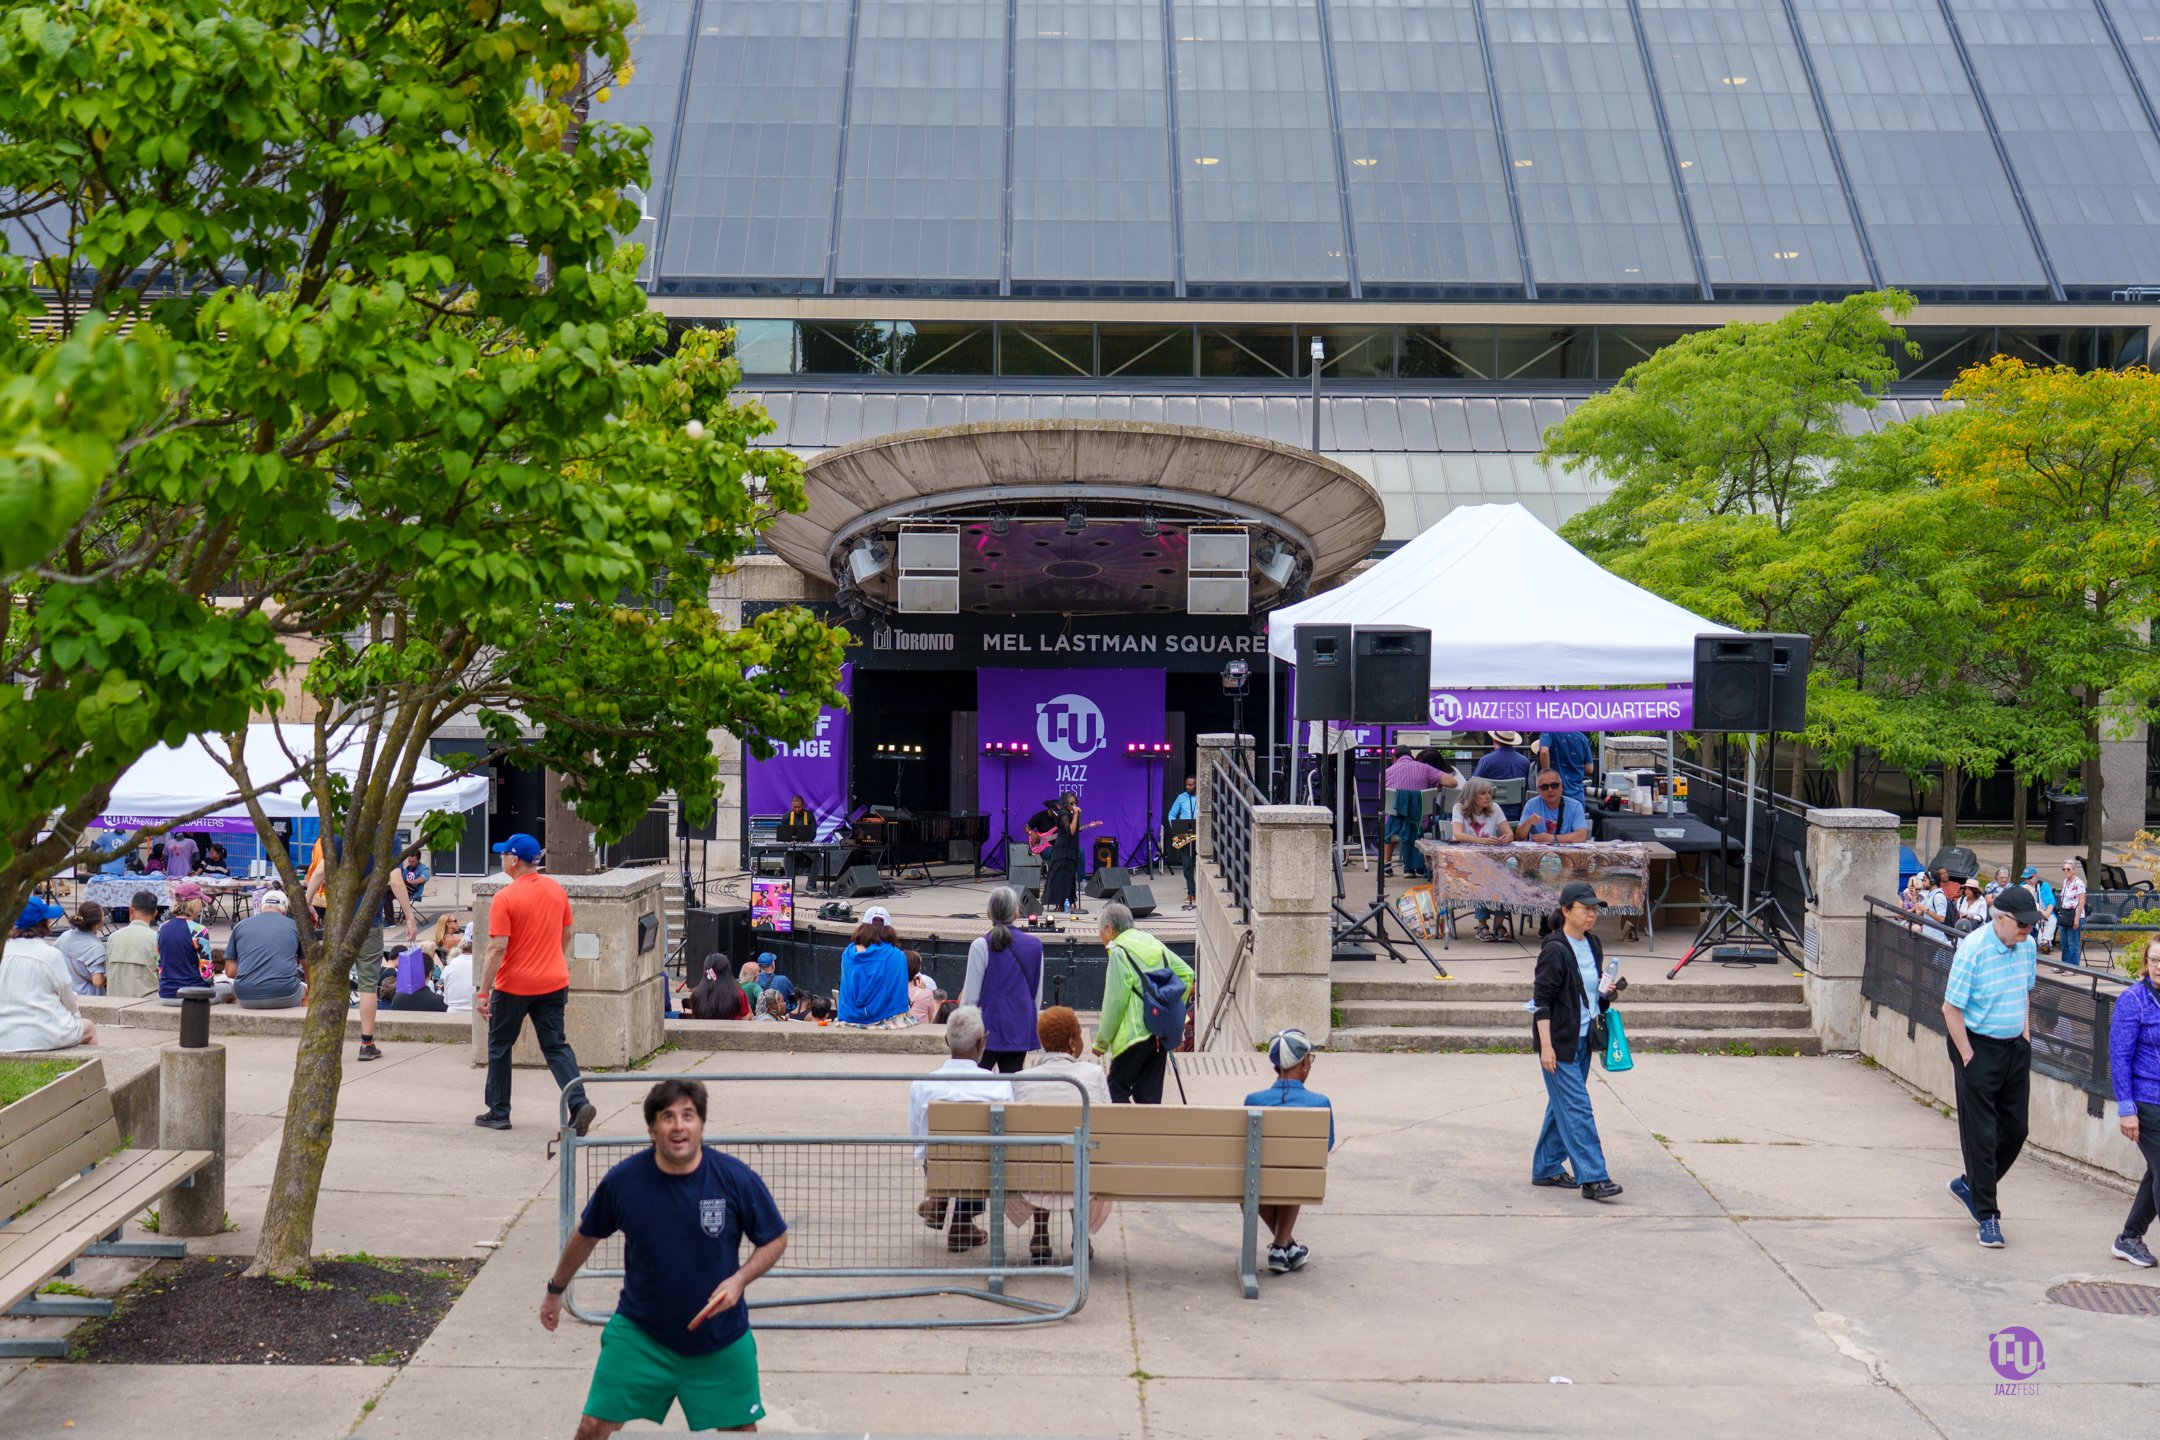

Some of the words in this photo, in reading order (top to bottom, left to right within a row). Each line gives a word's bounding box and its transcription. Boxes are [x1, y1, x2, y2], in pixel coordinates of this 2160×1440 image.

[894, 629, 954, 650] TORONTO
[983, 634, 1032, 651] MEL
[1040, 634, 1157, 652] LASTMAN
[1165, 635, 1267, 652] SQUARE
[1466, 701, 1532, 719] JAZZFEST
[1536, 700, 1681, 719] HEADQUARTERS
[1055, 765, 1087, 781] JAZZ
